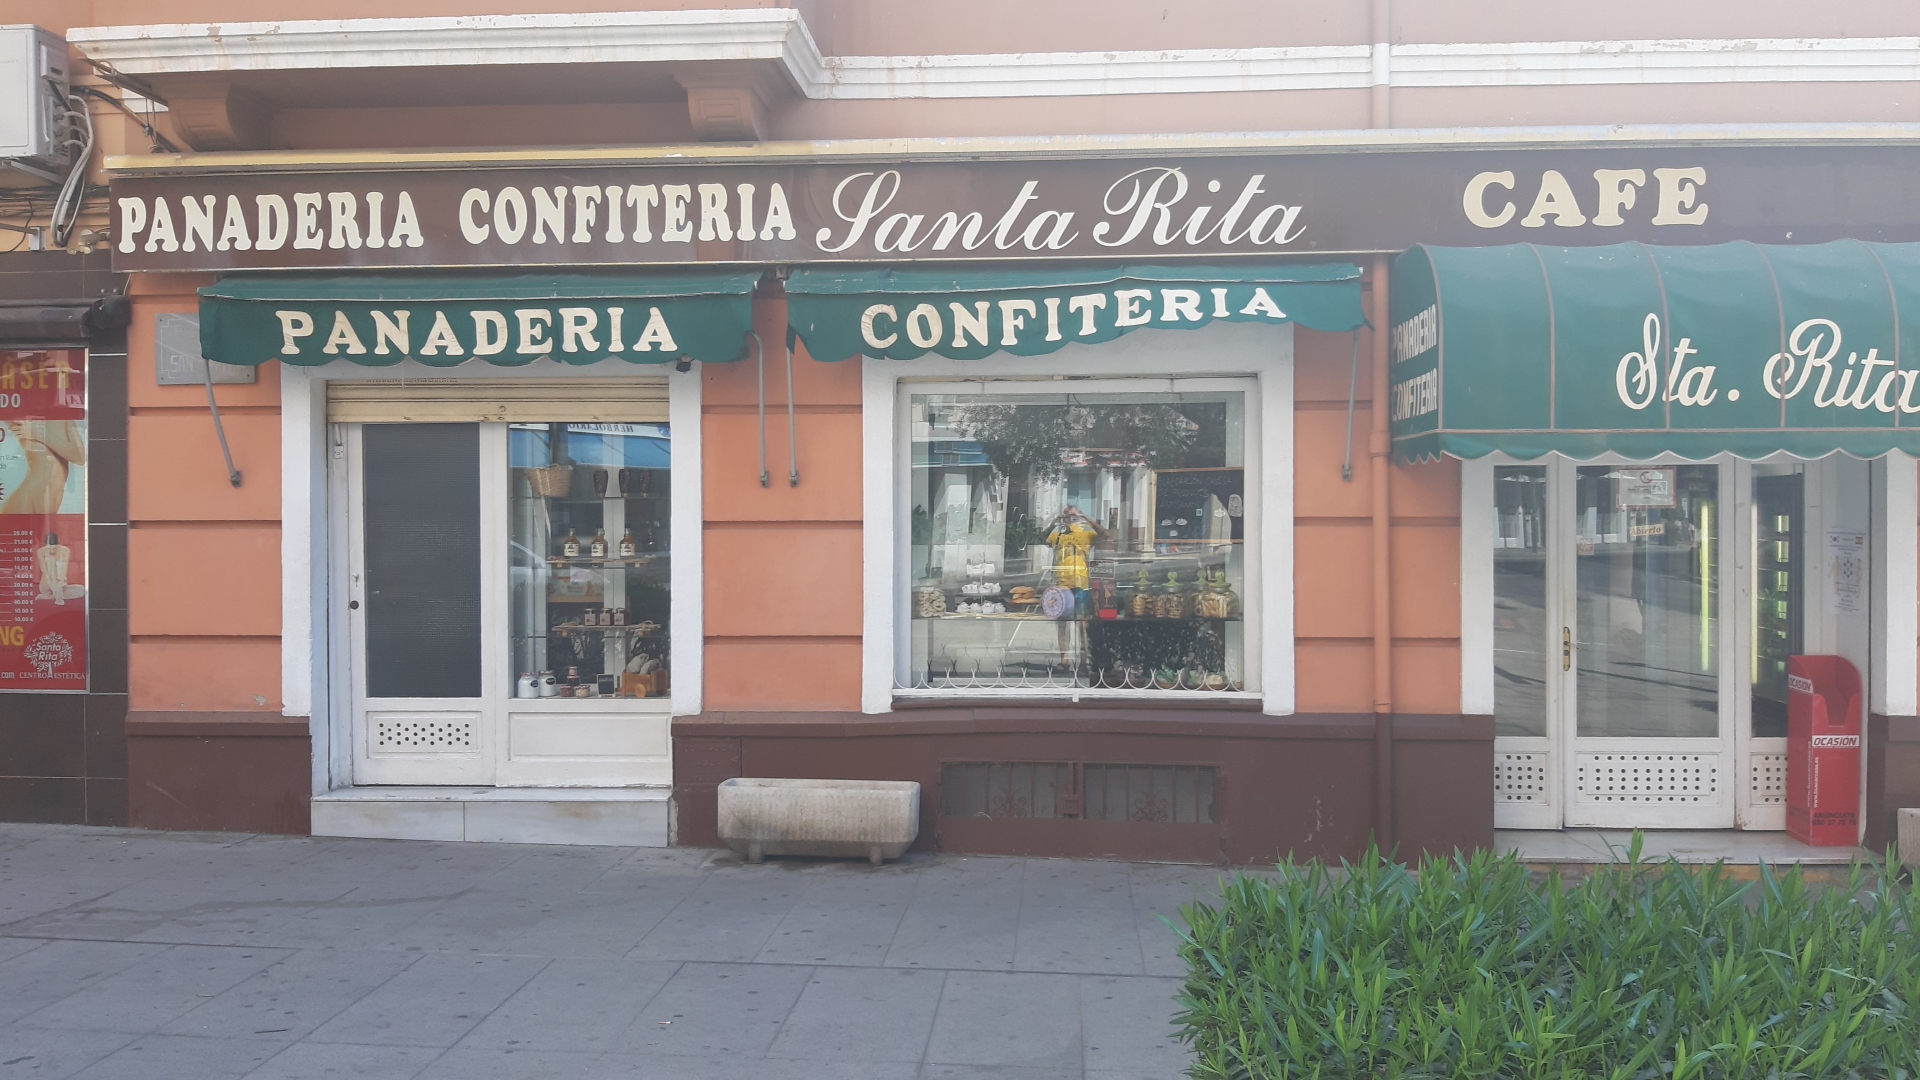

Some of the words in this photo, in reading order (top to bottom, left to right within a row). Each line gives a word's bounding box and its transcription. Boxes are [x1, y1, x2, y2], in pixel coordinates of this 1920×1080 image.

[118, 191, 424, 253] PANADERIA
[459, 183, 797, 244] CONFITERIA
[815, 170, 1079, 252] Santa
[1092, 166, 1307, 247] Rita
[1463, 166, 1709, 229] CAFE
[275, 307, 678, 356] PANADERIA
[861, 288, 1287, 348] CONFITERIA
[1391, 303, 1437, 363] PANADERIA
[1616, 313, 1740, 410] Sta.
[1763, 318, 1920, 413] Rita
[1391, 367, 1438, 421] CONFITERIA
[1630, 526, 1661, 535] Abierto
[36, 642, 61, 651] Santa
[38, 651, 58, 660] Rita
[54, 671, 85, 679] ESTÉTICA
[1813, 735, 1857, 746] OCASIÓN
